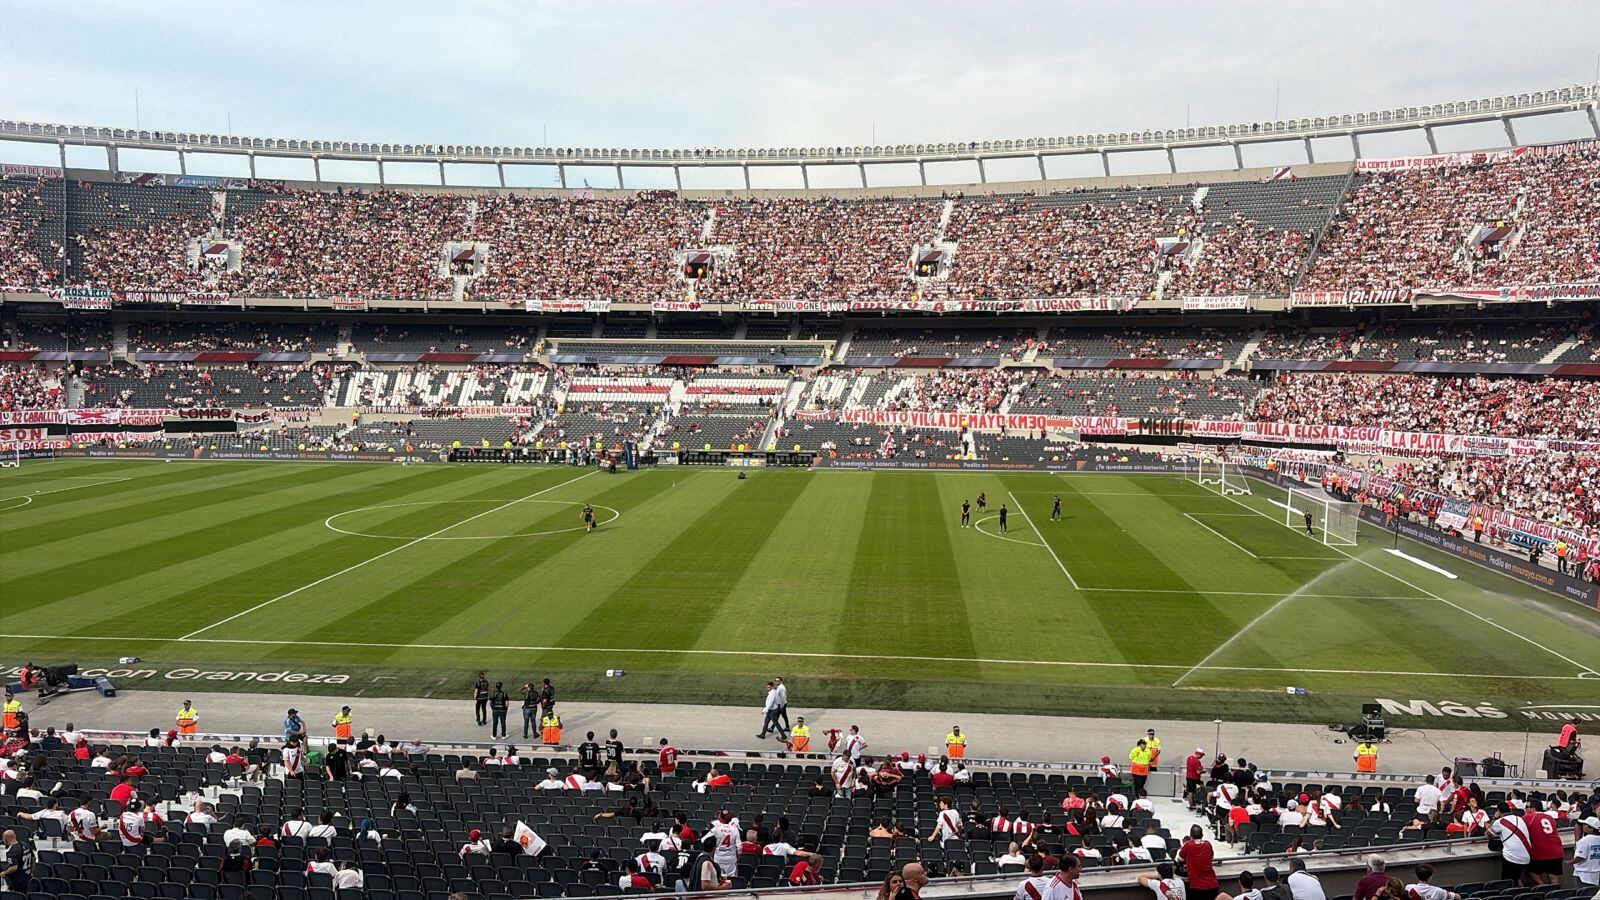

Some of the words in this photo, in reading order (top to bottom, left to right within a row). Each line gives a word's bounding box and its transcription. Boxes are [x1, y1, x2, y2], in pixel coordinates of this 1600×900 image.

[65, 288, 109, 297] ROSARIO
[126, 292, 144, 302] HUGO
[145, 292, 150, 302] Y
[151, 292, 168, 302] NADA
[978, 301, 1020, 310] WILDE
[1036, 299, 1081, 310] LUGANO
[24, 411, 64, 422] CABALLITO
[180, 408, 232, 419] LOMAS
[236, 411, 271, 422] FEDE
[911, 411, 946, 428] VILLA
[969, 414, 1004, 429] MAYO
[1075, 417, 1118, 429] SOLANO
[1256, 422, 1290, 437] VILLA
[1295, 425, 1329, 439] ELISA
[1391, 432, 1406, 447] LA
[1410, 434, 1446, 450] PLATA
[1381, 447, 1421, 458] TRENQUE
[1512, 515, 1553, 540] AVELLANEDA
[82, 667, 157, 678] con
[164, 667, 350, 685] Grandeza
[1375, 697, 1508, 719] Más
[1540, 818, 1553, 835] 9
[721, 835, 731, 848] 4
